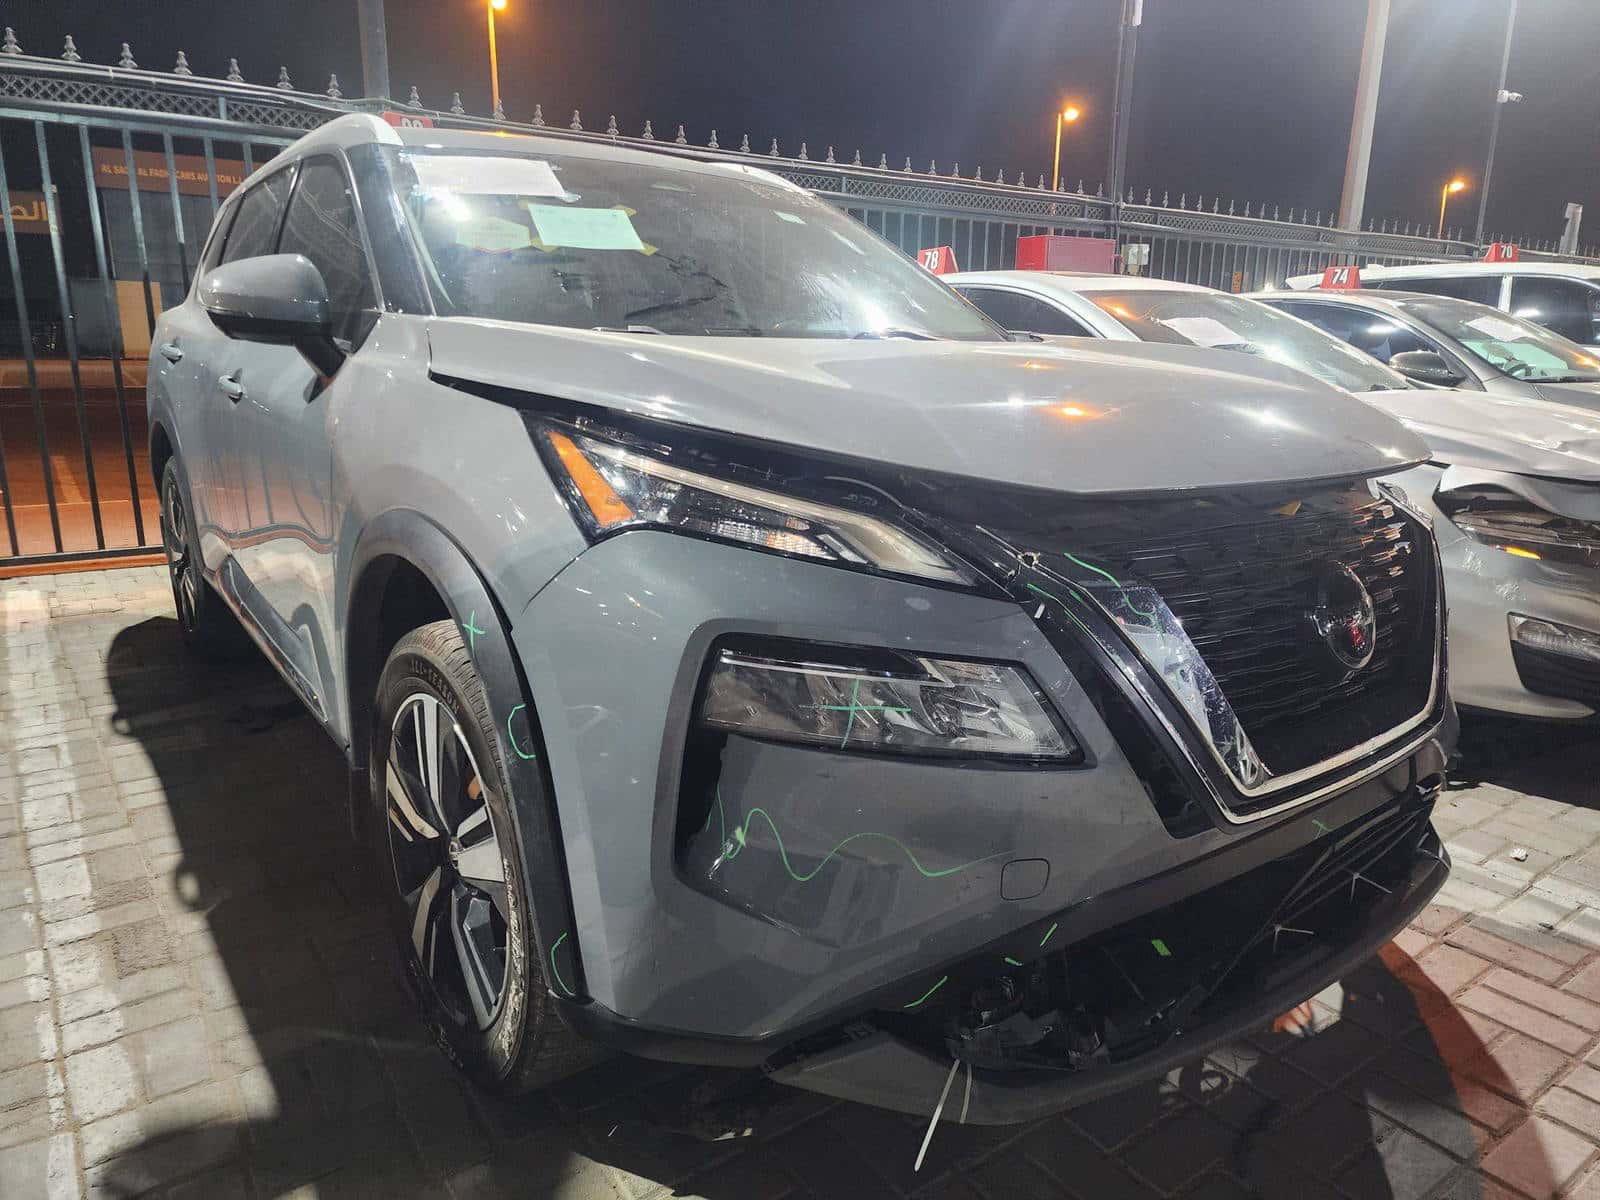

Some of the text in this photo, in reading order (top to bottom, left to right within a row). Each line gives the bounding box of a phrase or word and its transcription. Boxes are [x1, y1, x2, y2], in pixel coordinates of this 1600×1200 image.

[924, 250, 939, 269] 78
[1500, 245, 1513, 258] 70
[1332, 269, 1349, 285] 74
